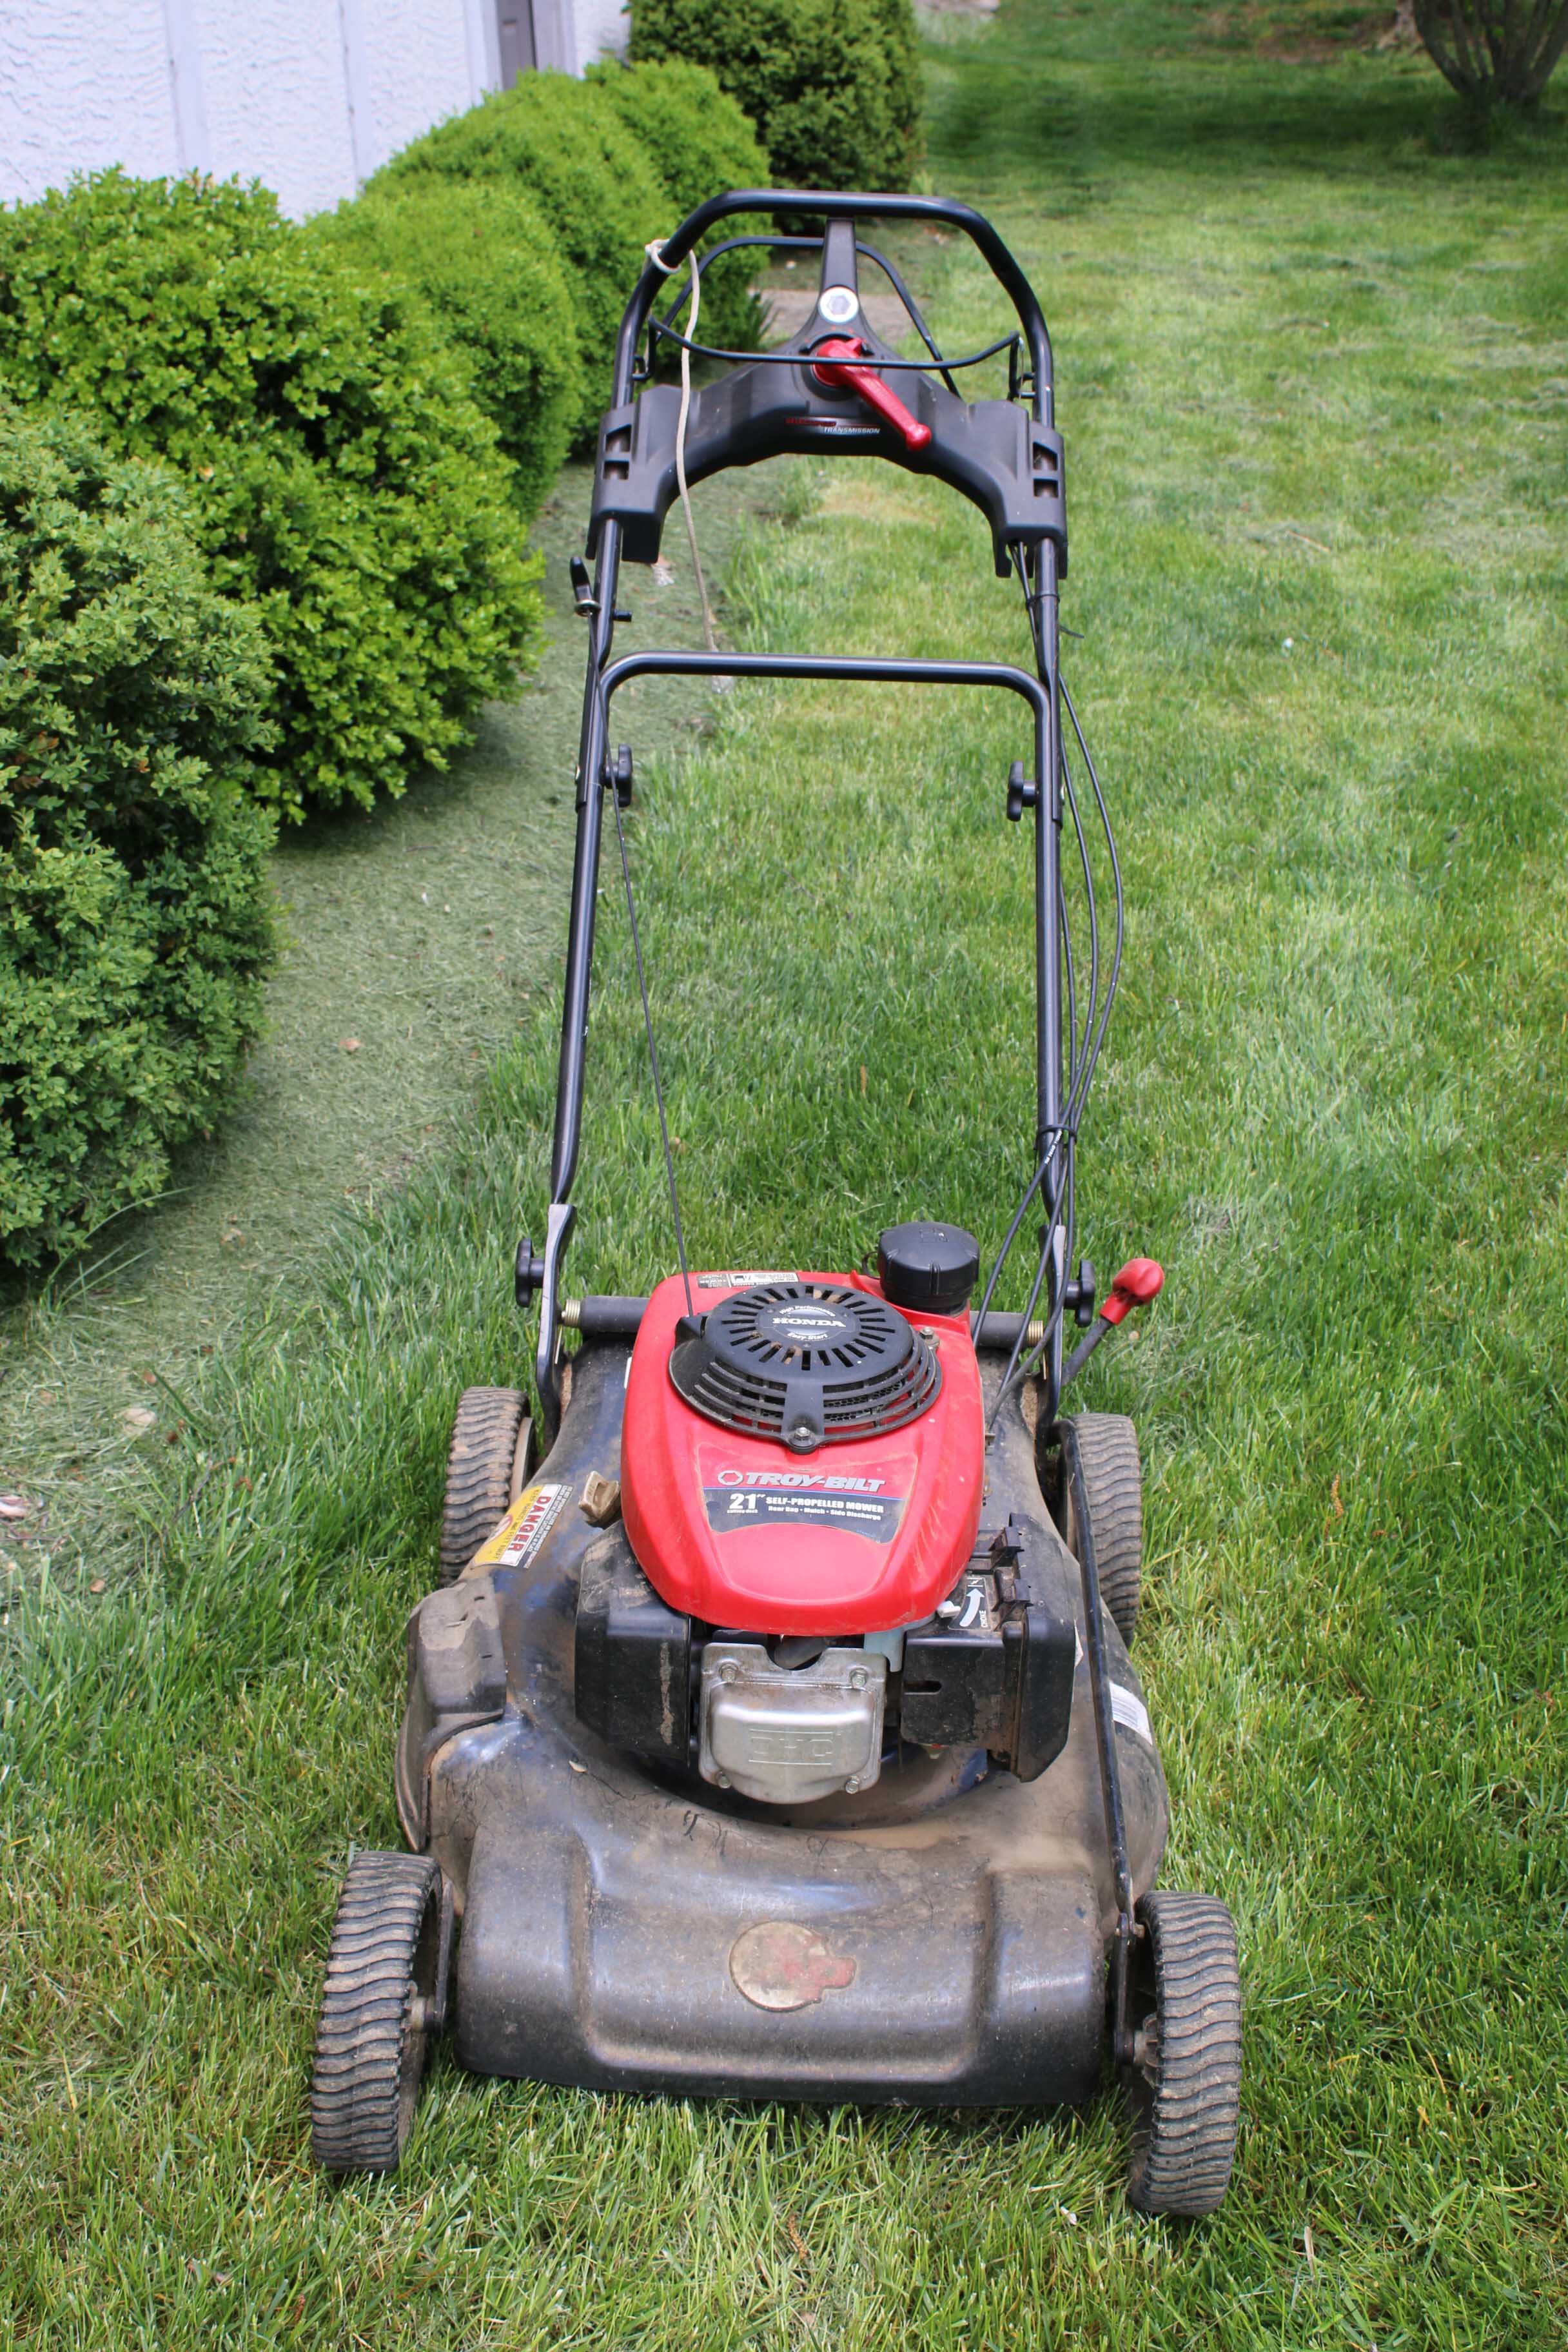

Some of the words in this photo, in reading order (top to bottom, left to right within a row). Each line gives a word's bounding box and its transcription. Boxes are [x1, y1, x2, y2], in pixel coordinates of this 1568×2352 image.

[778, 1306, 794, 1315] High
[794, 1305, 836, 1317] Performance
[772, 1317, 847, 1328] HONDA
[787, 1332, 805, 1340] Easy
[746, 1472, 886, 1492] TROY-BILT
[765, 1496, 845, 1509] SELF-PROPELLED
[845, 1501, 885, 1514] MOWER
[846, 1511, 881, 1521] Discharge
[507, 1496, 552, 1552] DANGER
[979, 1610, 988, 1628] CHOKE
